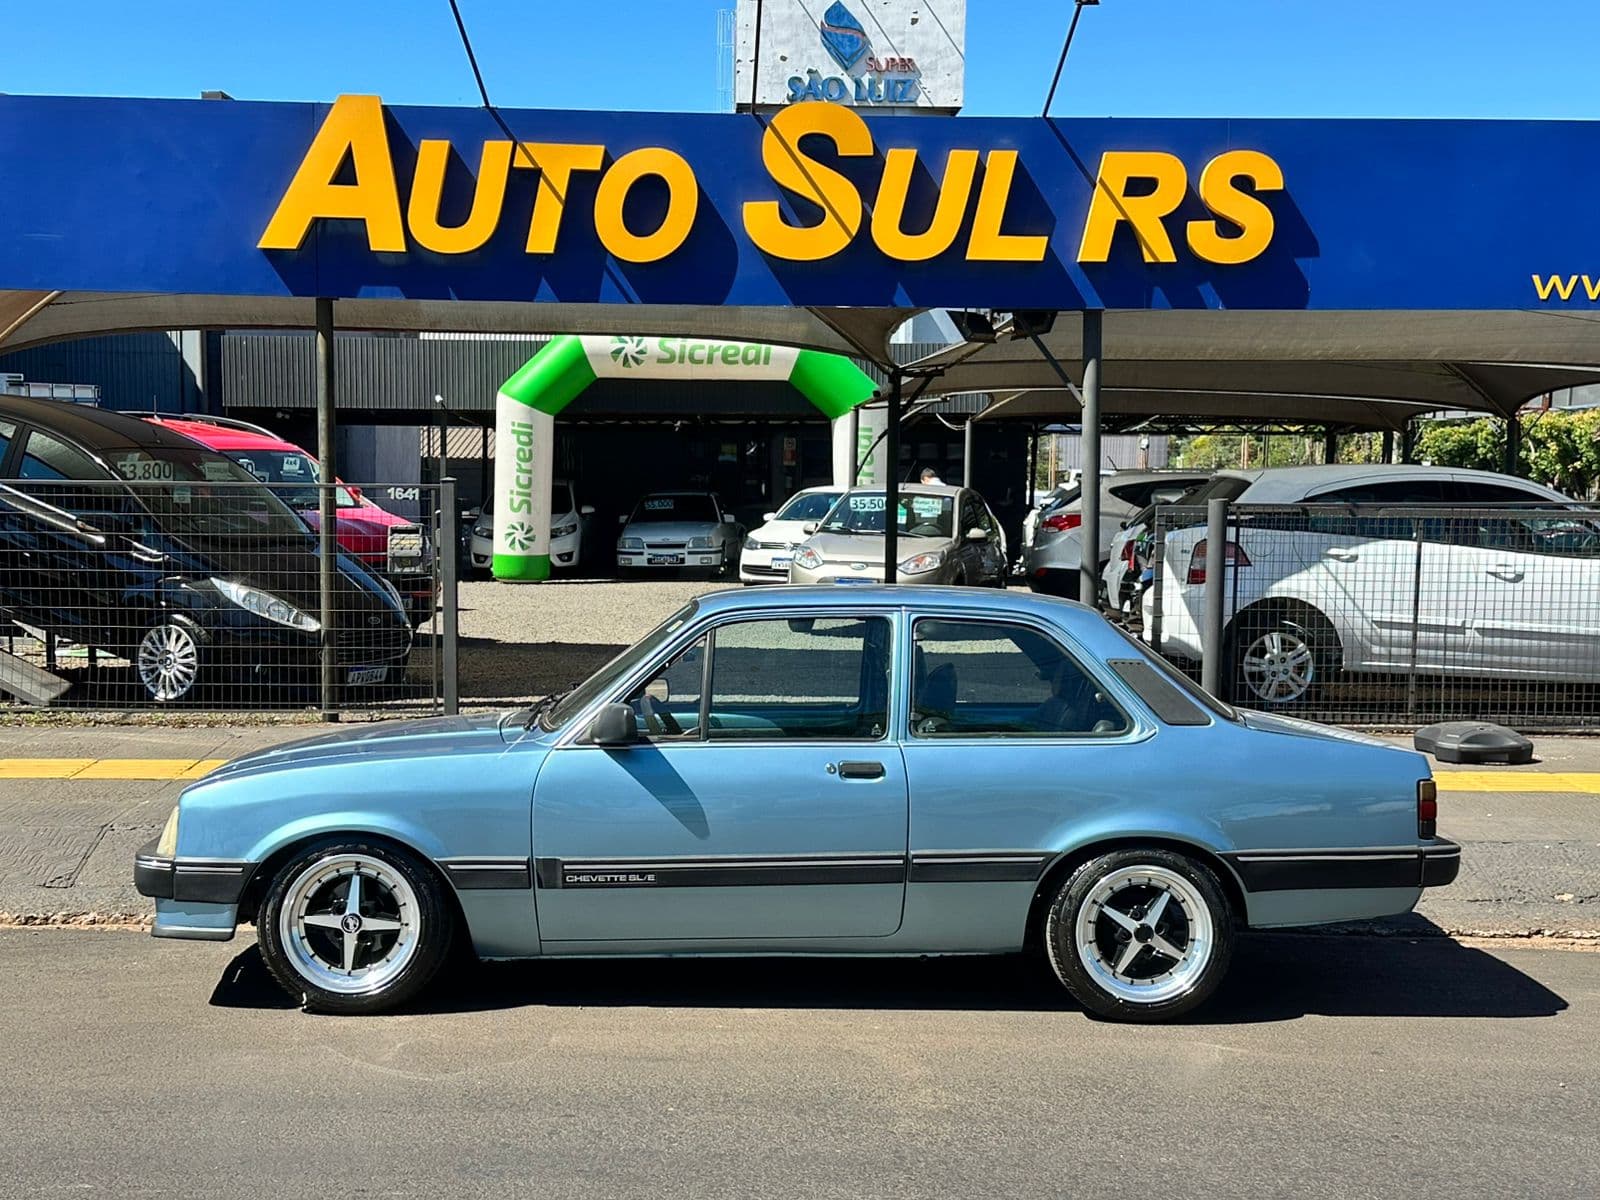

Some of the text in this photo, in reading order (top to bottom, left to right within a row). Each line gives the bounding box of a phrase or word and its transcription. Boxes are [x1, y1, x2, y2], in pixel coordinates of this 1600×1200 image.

[866, 57, 915, 72] SUPER
[854, 79, 918, 102] LUIZ
[256, 94, 1284, 264] AUTO SUL RS
[509, 421, 534, 515] Sicredi
[387, 487, 420, 500] 1641
[566, 874, 627, 882] CHEVETTE
